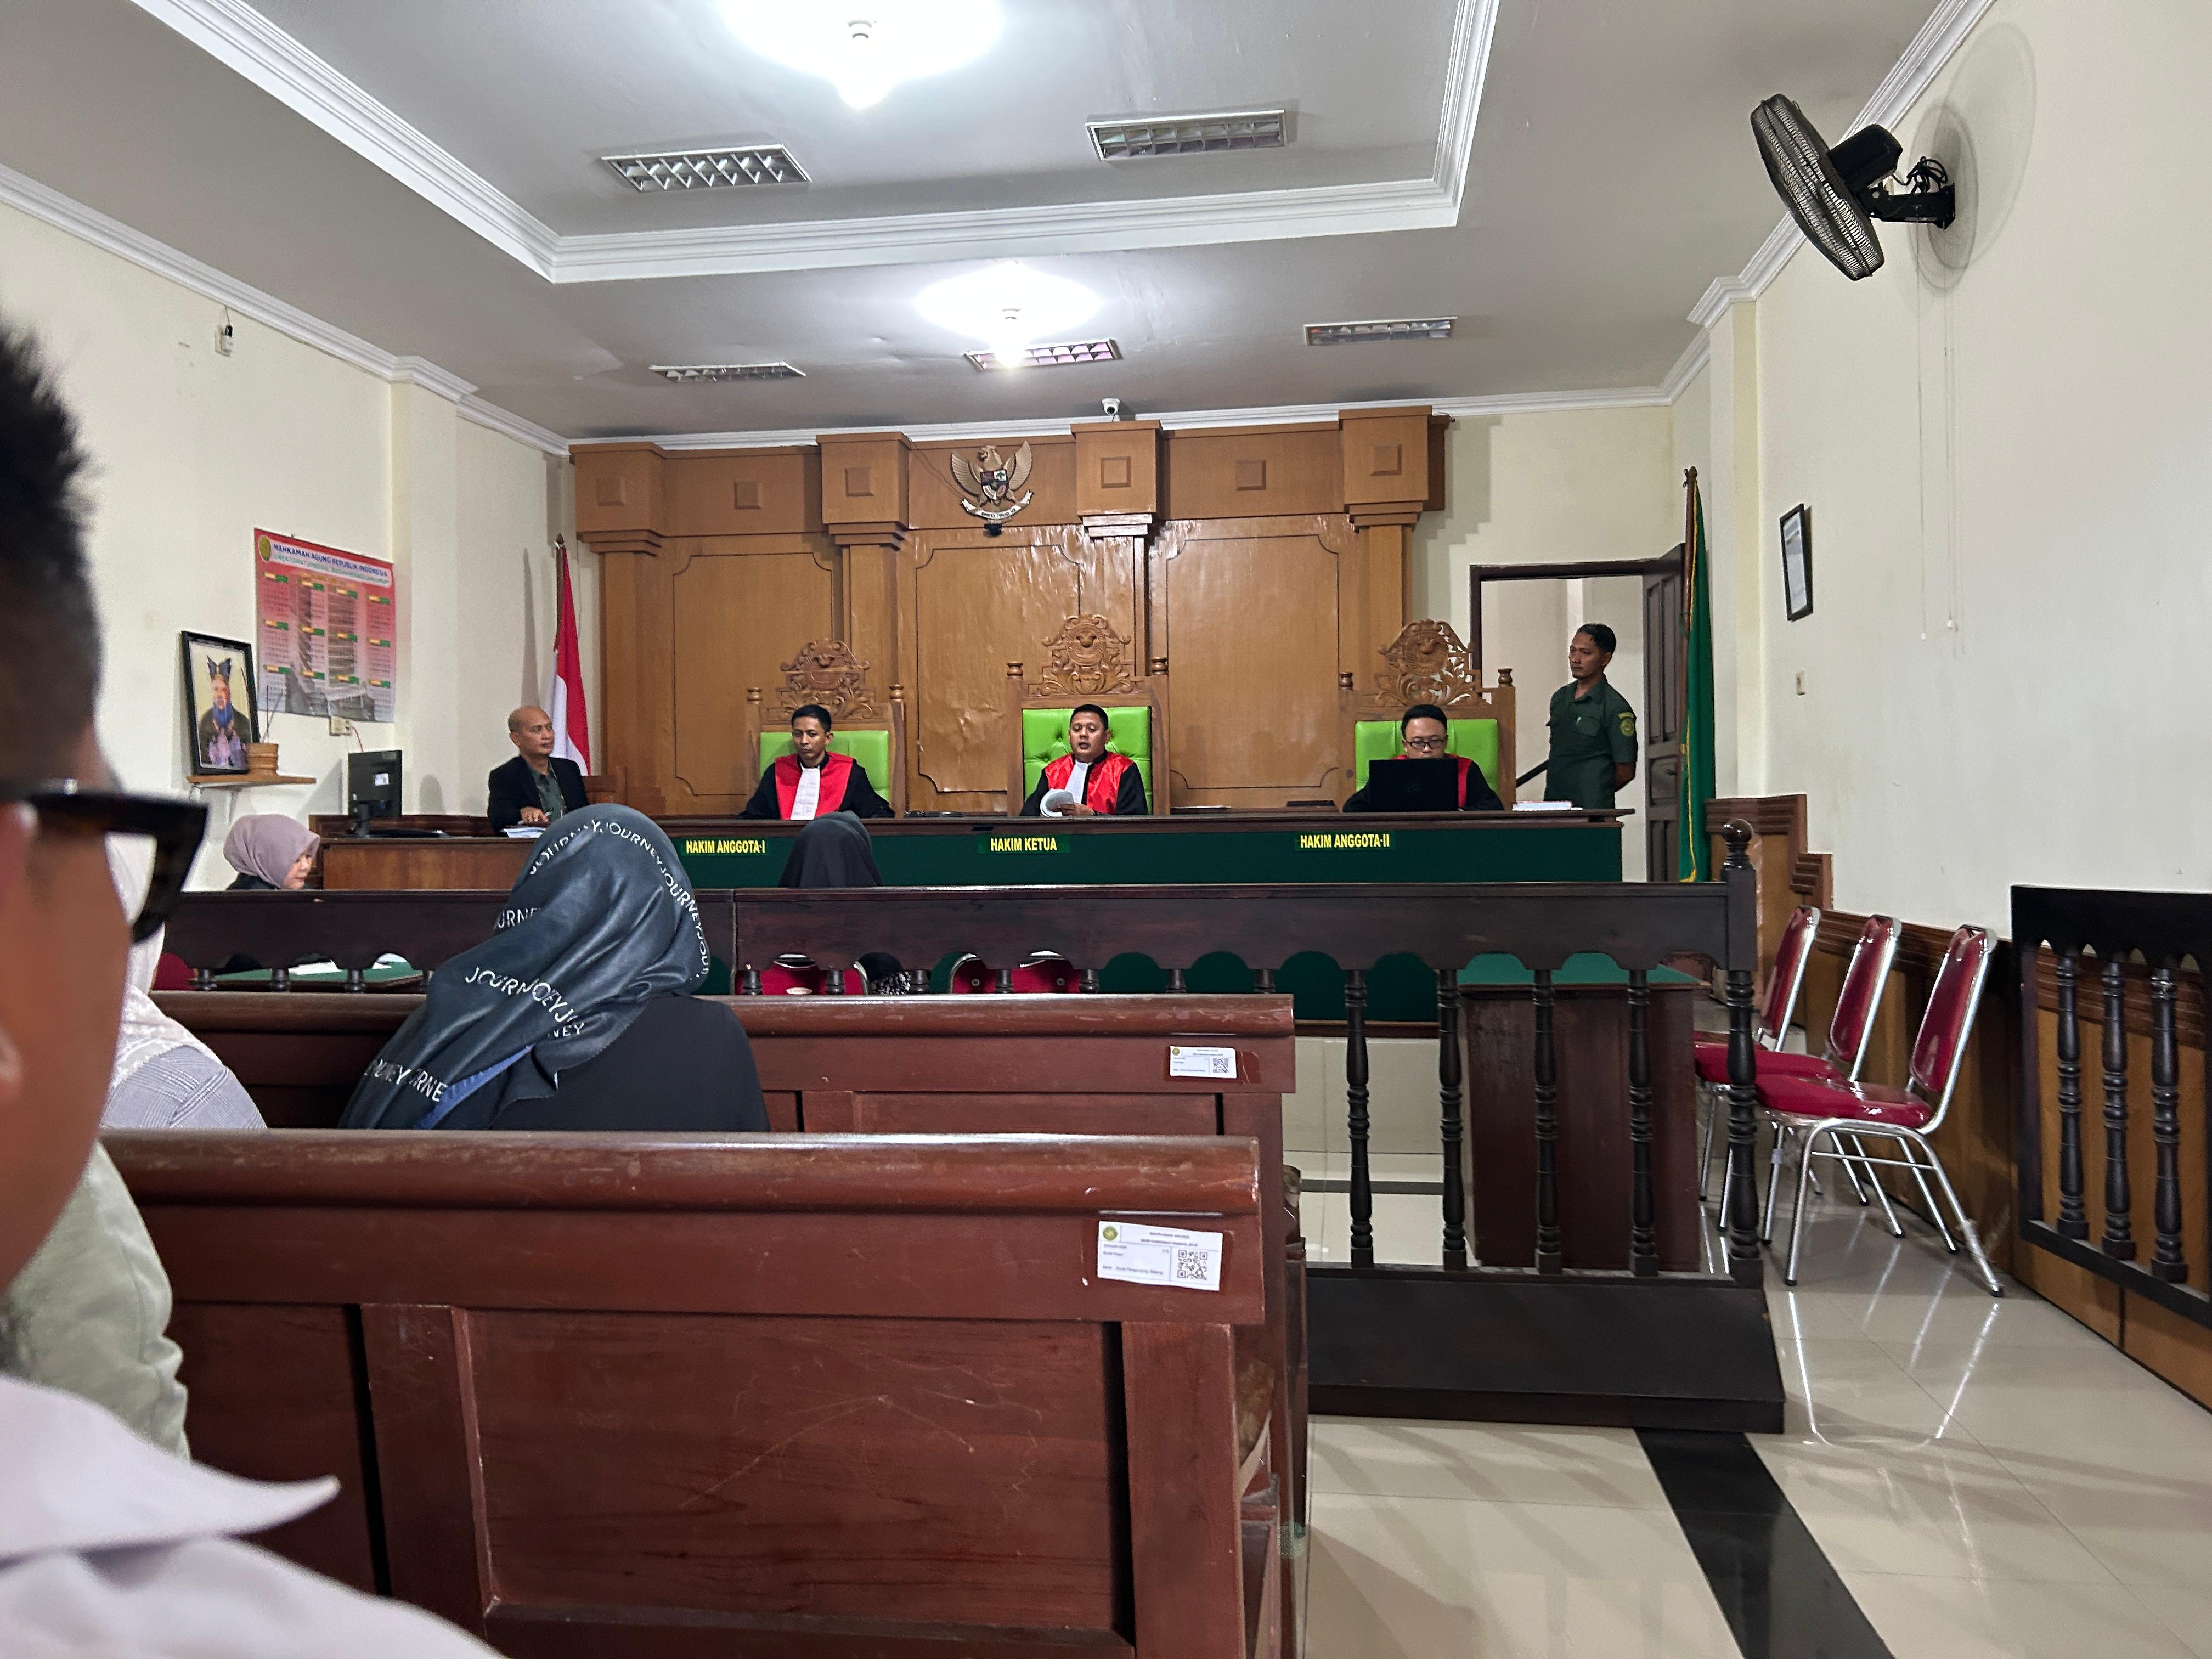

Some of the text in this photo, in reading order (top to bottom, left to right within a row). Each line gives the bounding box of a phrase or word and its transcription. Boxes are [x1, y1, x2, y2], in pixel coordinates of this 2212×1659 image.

[686, 839, 765, 853] HAKIM ANGGOTA-I
[991, 837, 1058, 851] HAKIM KETUA
[1300, 833, 1390, 848] HAKIM ANGGOTA-II
